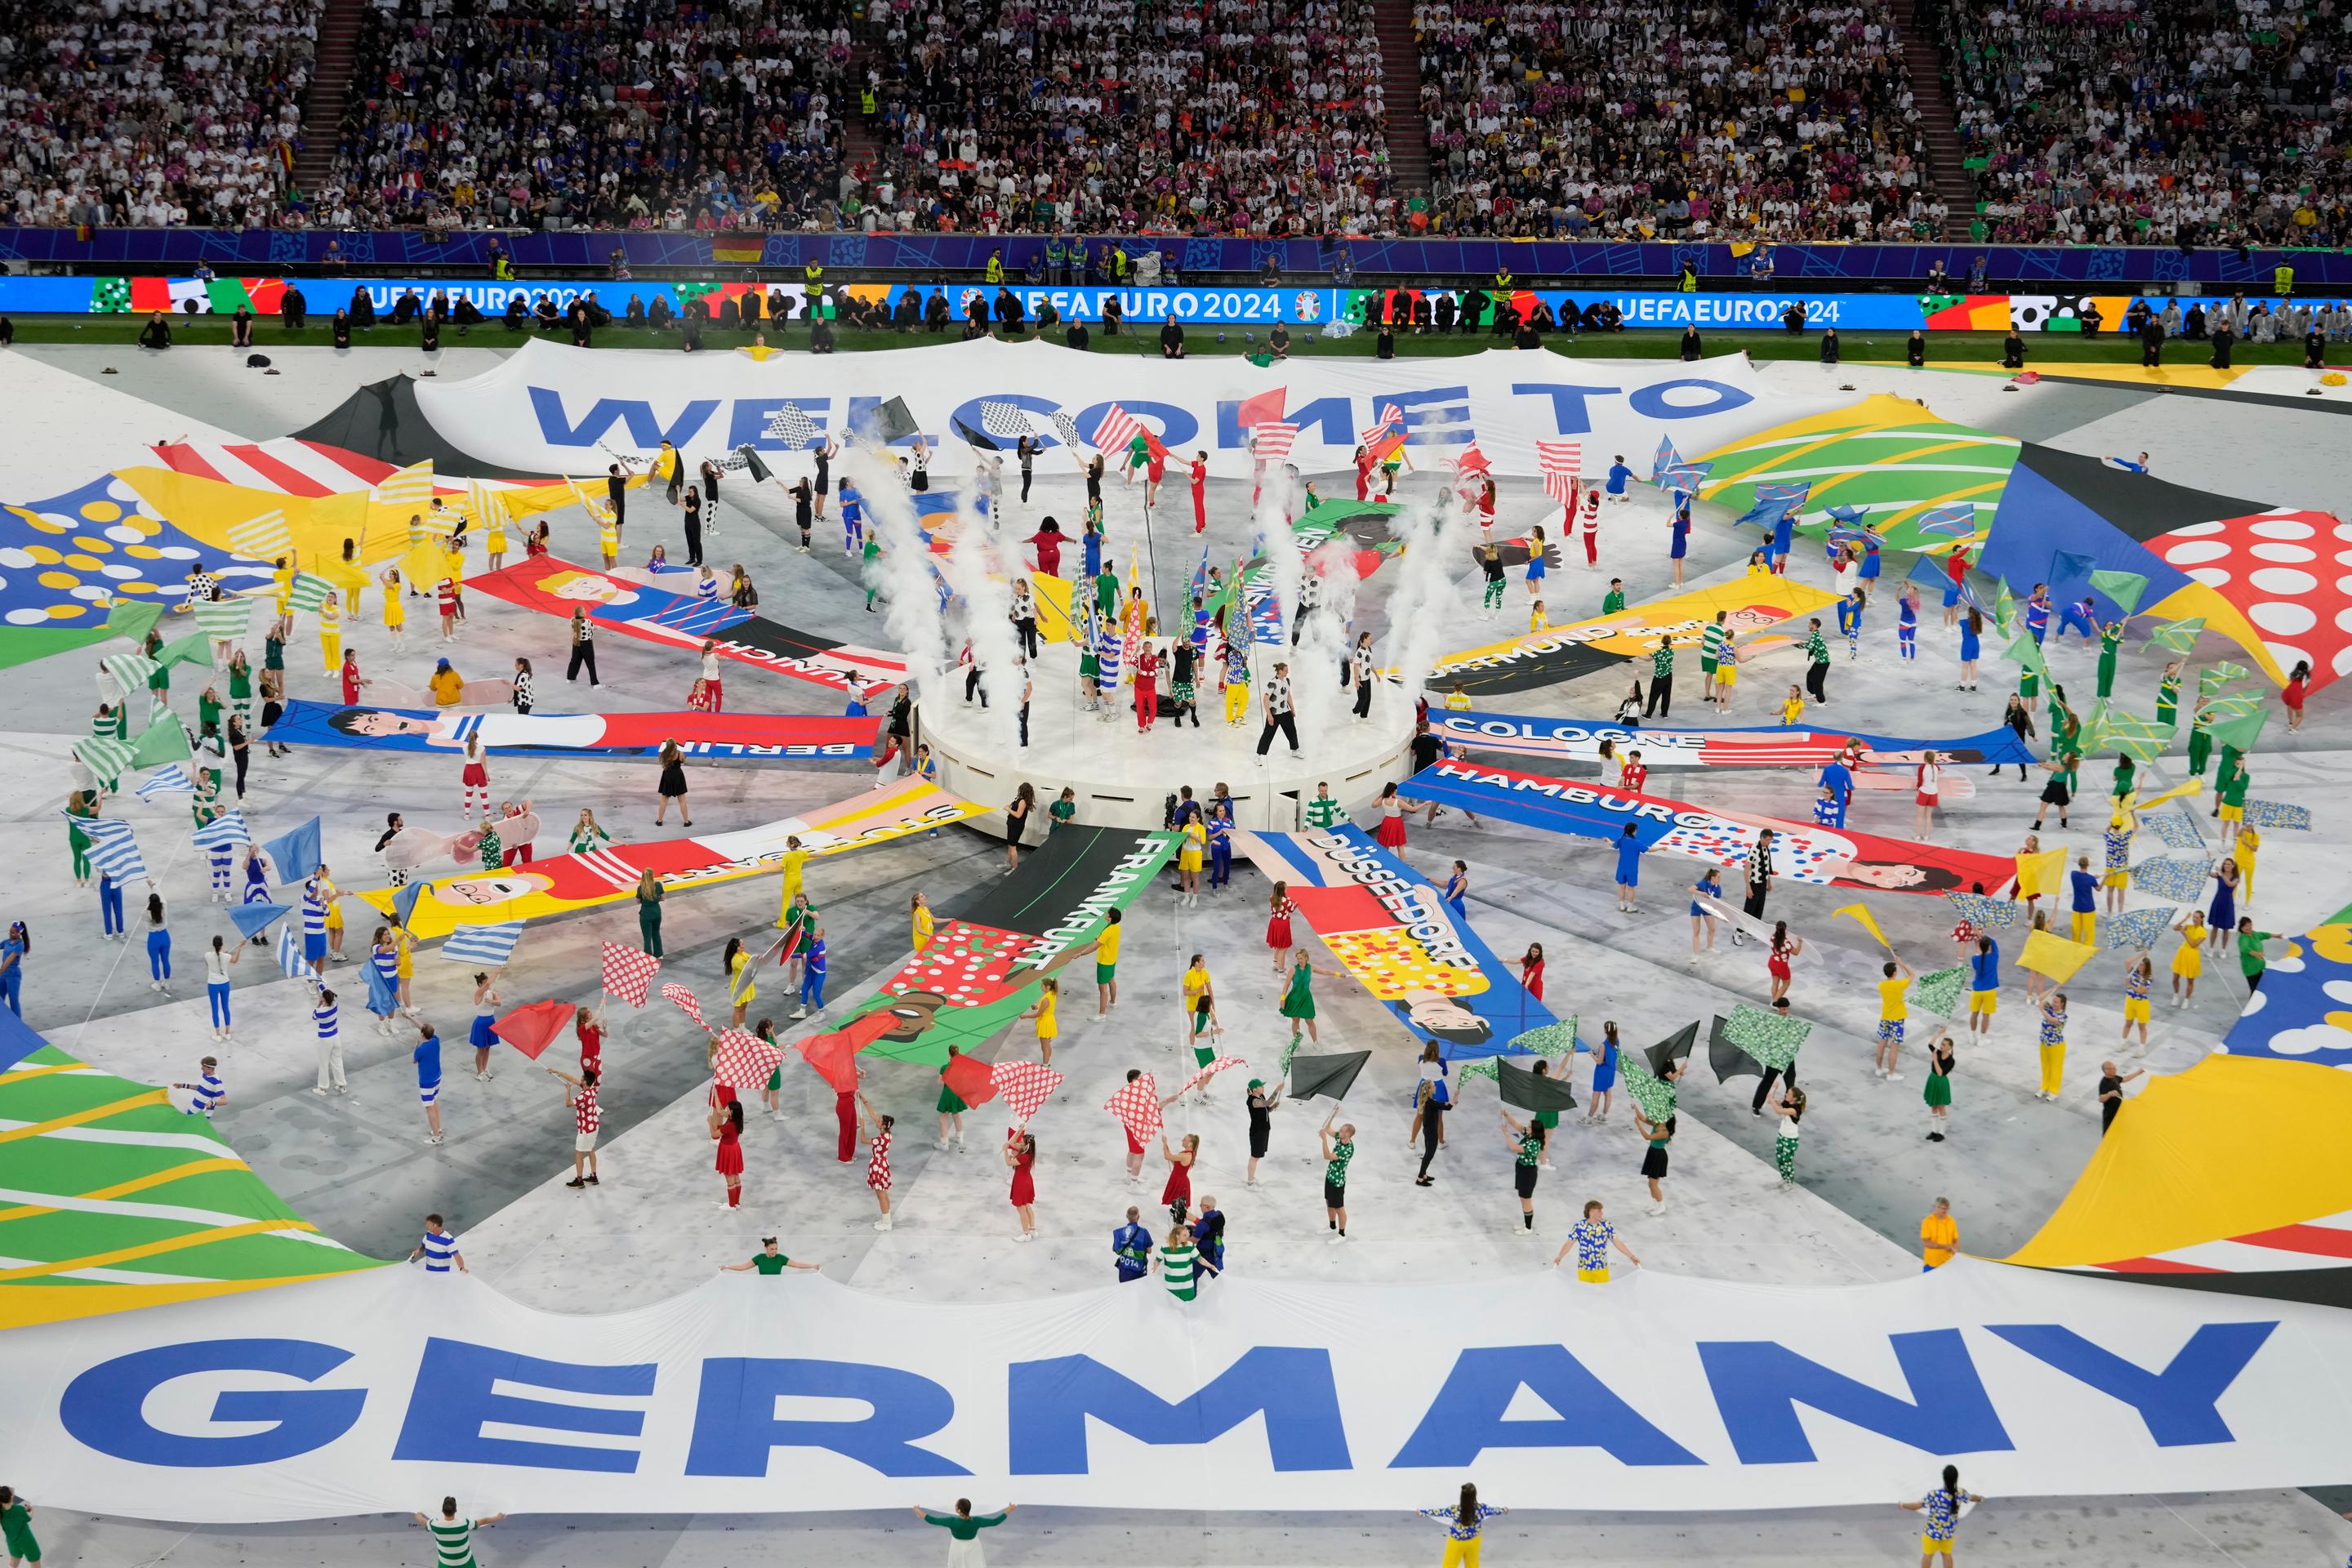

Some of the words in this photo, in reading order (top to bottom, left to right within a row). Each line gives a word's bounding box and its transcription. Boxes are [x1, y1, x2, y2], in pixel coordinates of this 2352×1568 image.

[528, 386, 1475, 452] WELCOME
[1512, 378, 1754, 434] TO
[719, 639, 889, 690] MUNICH
[658, 741, 855, 755] BERLIN
[1444, 717, 1706, 748] COLOGNE
[1435, 764, 1714, 828] HAMBURG
[1012, 838, 1170, 971] FRANKFURT
[1309, 833, 1479, 969] DÜSSELDORF
[60, 1321, 2279, 1477] GERMANY
